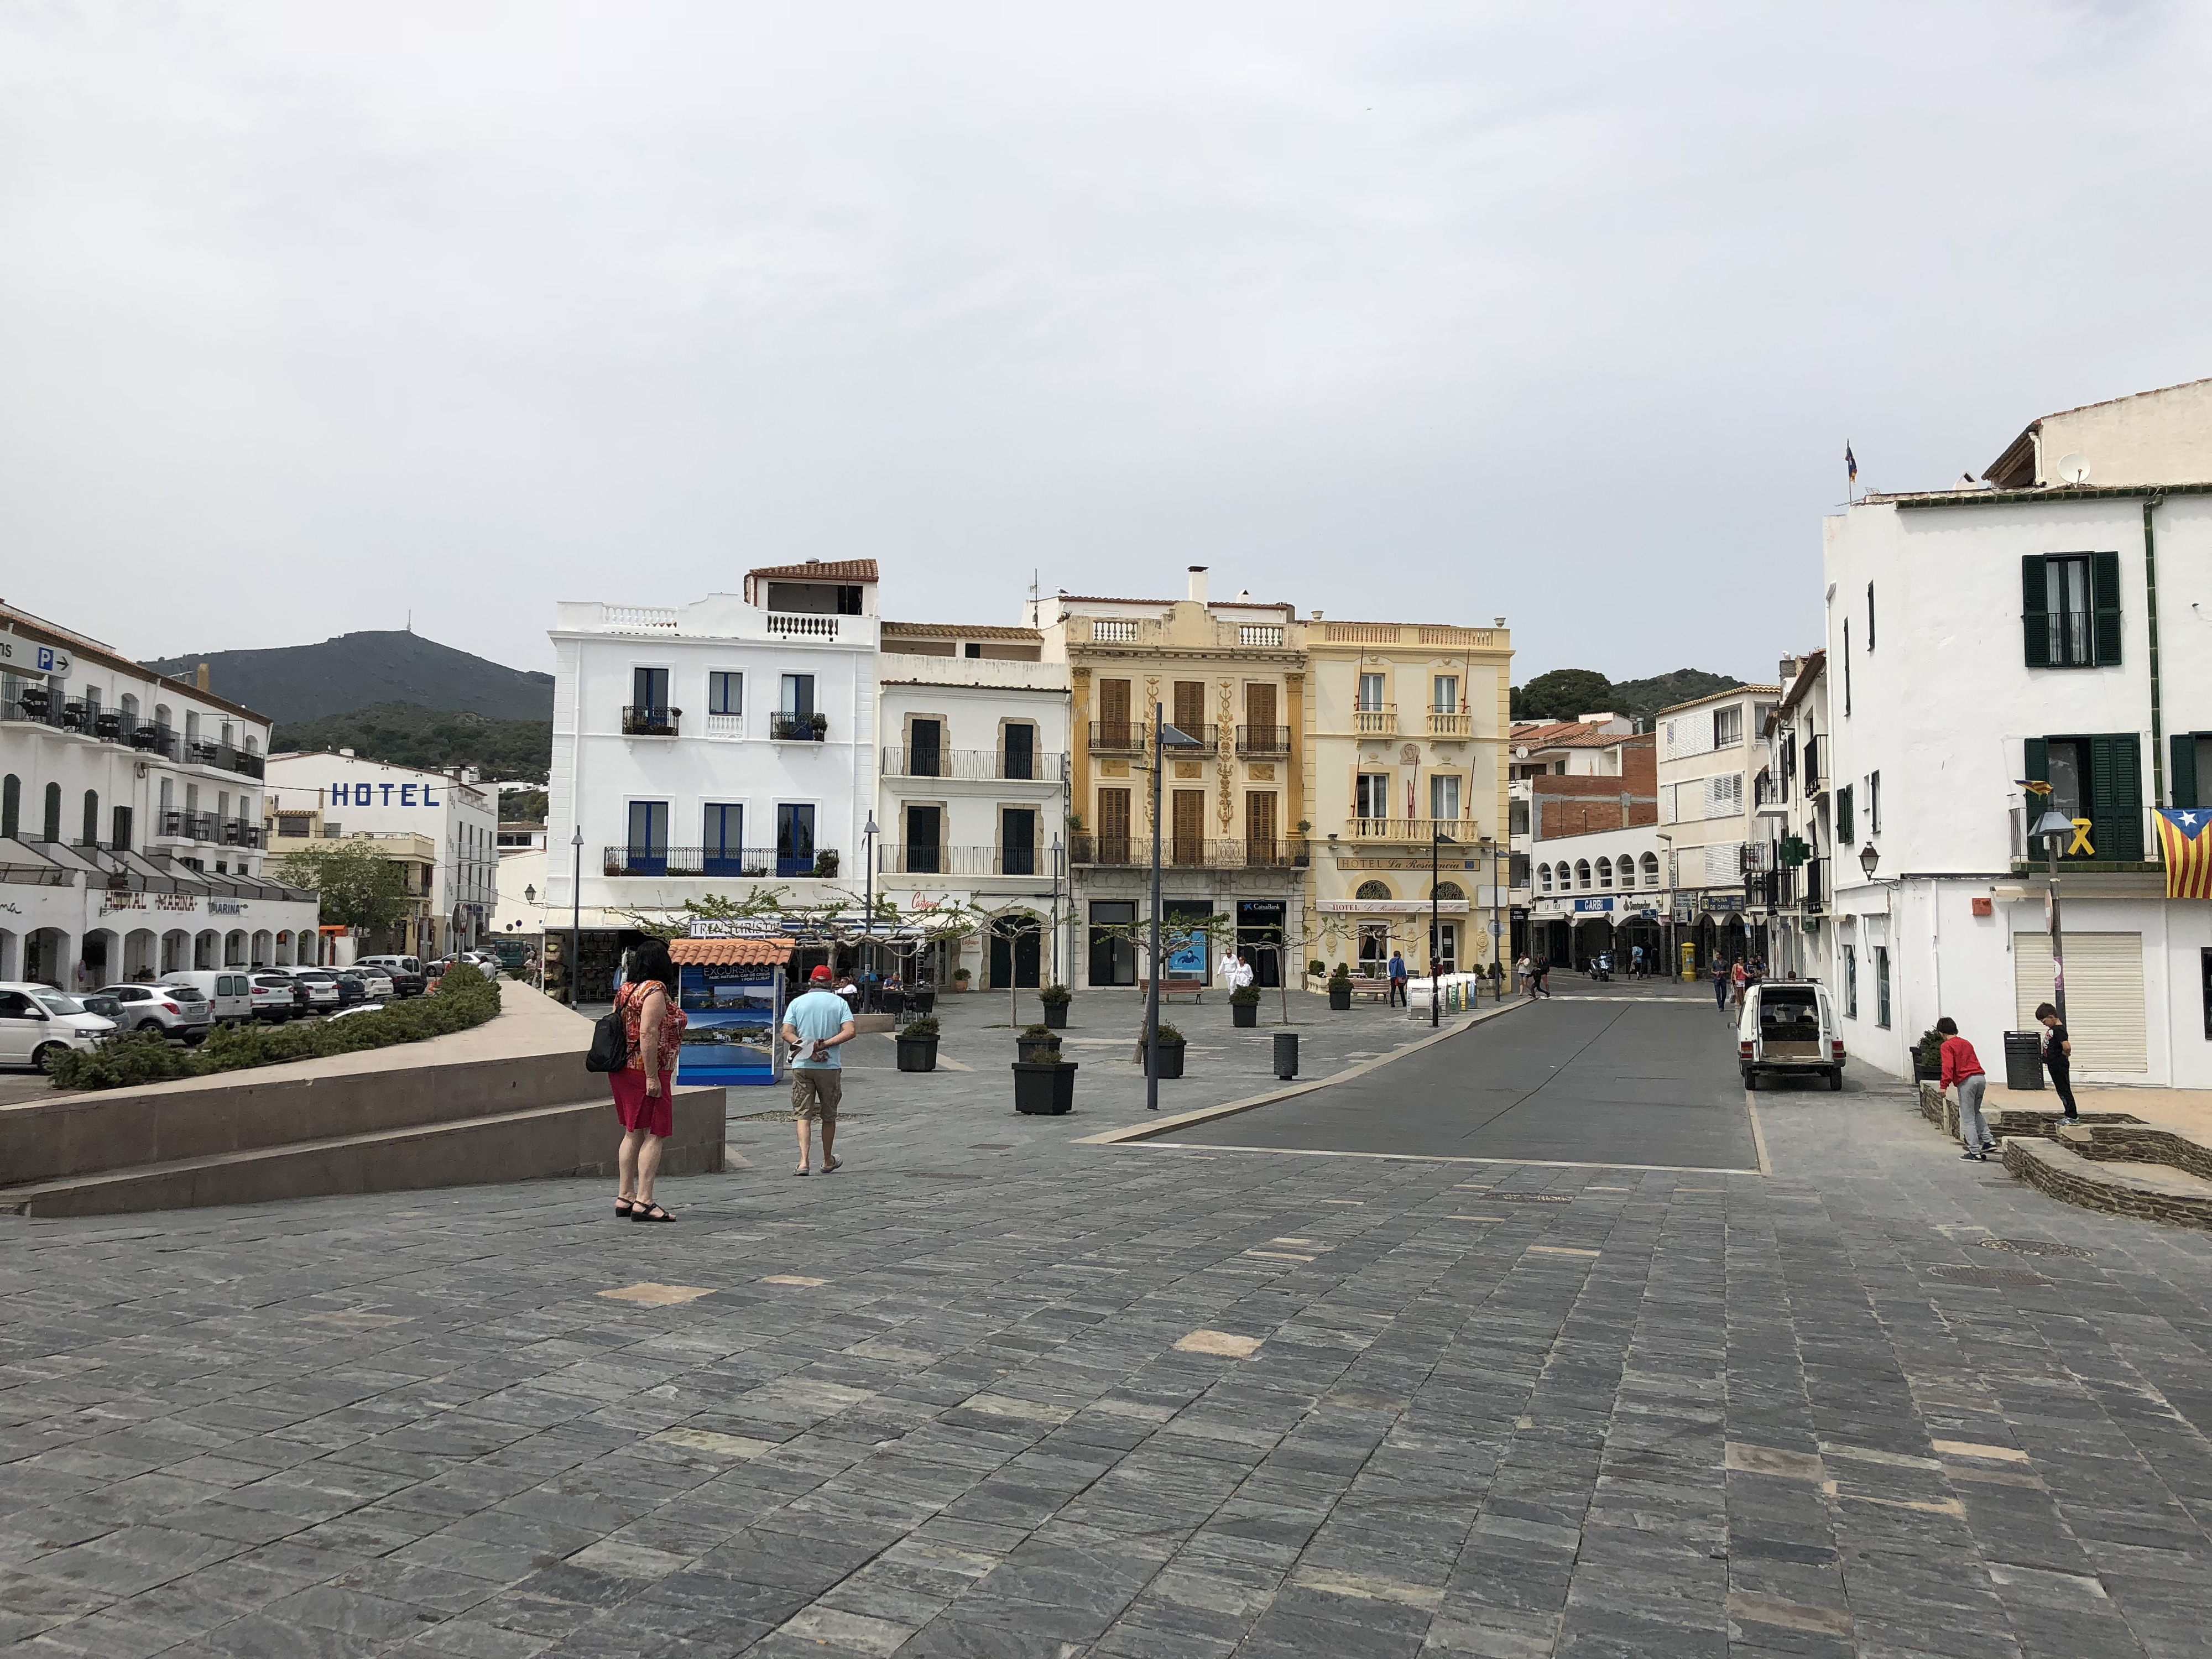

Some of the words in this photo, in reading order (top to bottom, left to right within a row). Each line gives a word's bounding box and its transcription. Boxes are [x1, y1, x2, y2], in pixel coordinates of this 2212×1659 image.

[40, 649, 51, 667] P
[332, 783, 440, 807] HOTEL
[1342, 859, 1382, 868] HOTEL
[1387, 859, 1401, 869] La
[1406, 859, 1459, 869] Residncia
[157, 894, 195, 911] MARINA
[211, 903, 240, 914] MARINA
[911, 891, 941, 910] Castañer
[691, 923, 723, 935] TREN
[726, 920, 780, 935] TURÍSTI
[704, 964, 770, 976] EXCURSIONS
